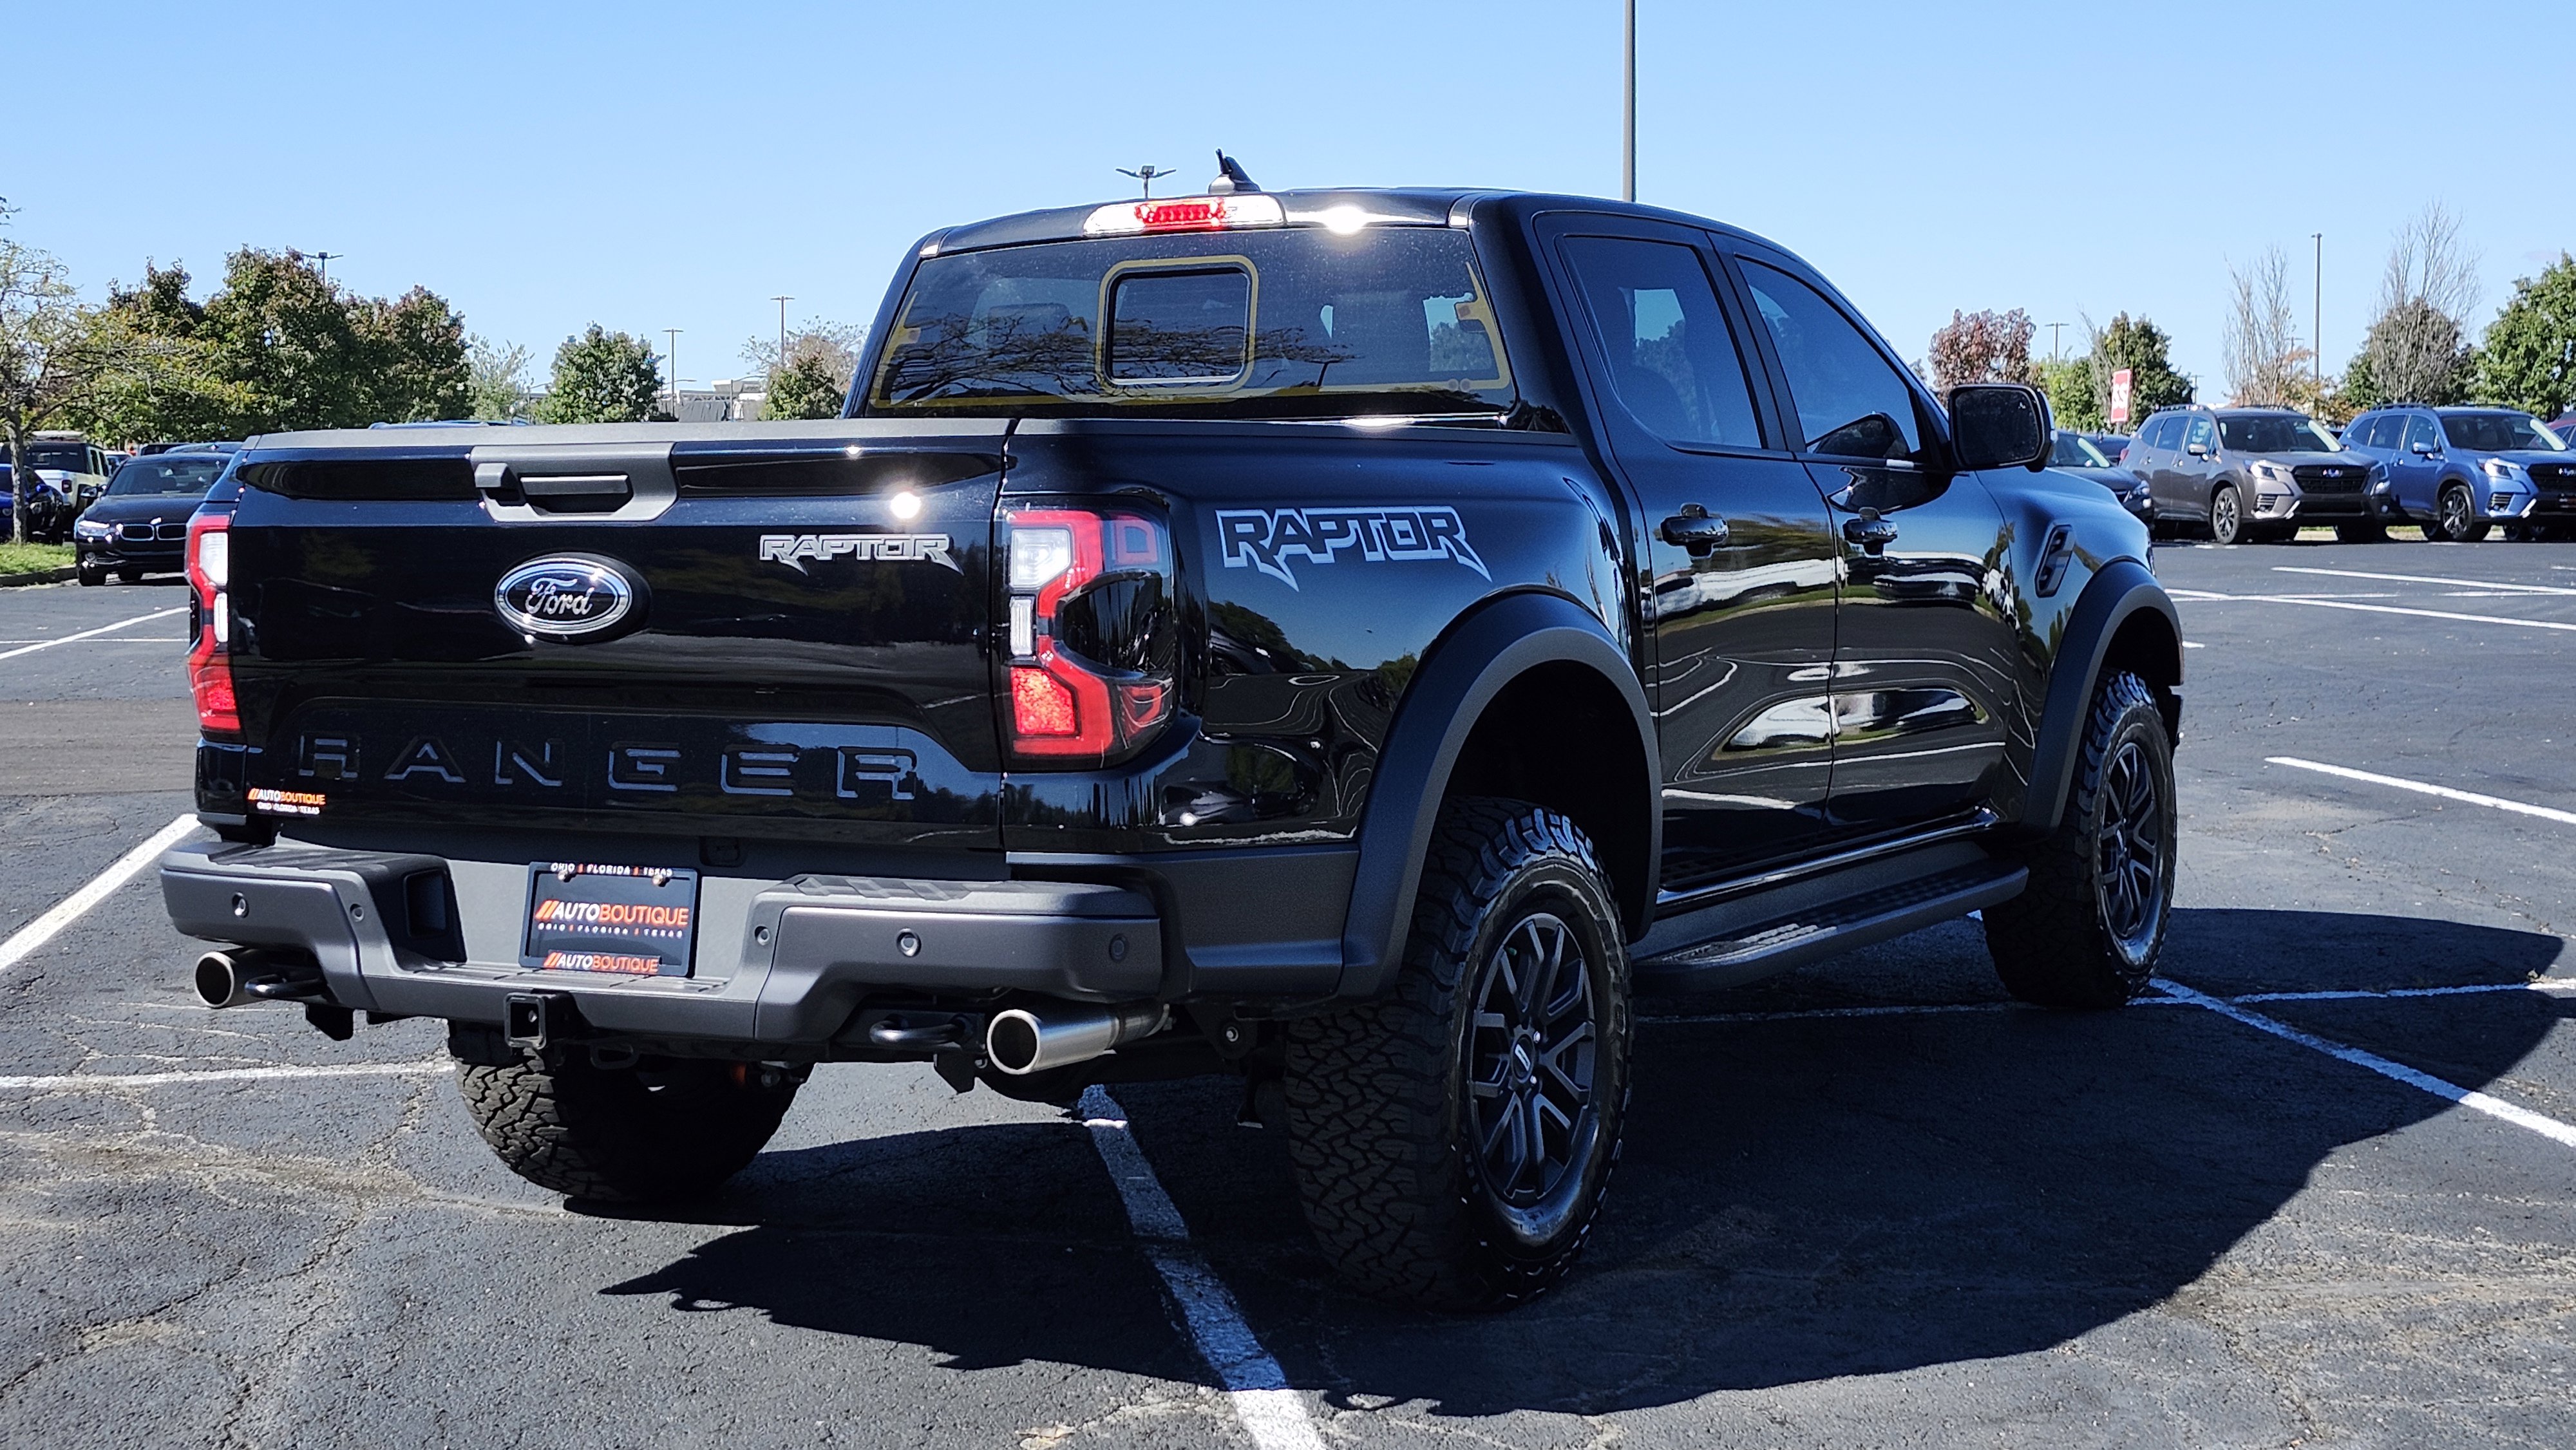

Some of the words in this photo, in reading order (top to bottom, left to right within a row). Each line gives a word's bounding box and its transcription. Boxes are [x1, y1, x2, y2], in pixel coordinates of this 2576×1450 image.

[759, 534, 965, 577] RAPTOR
[1215, 506, 1492, 592] RAPTOR
[525, 578, 595, 615] Ford
[298, 731, 917, 800] RANGER
[551, 863, 576, 873] OHIO
[586, 863, 630, 875] FLORIDA
[551, 901, 689, 926] AUTOBOUTIQUE
[556, 954, 659, 973] AUTOBOUTIQUE
